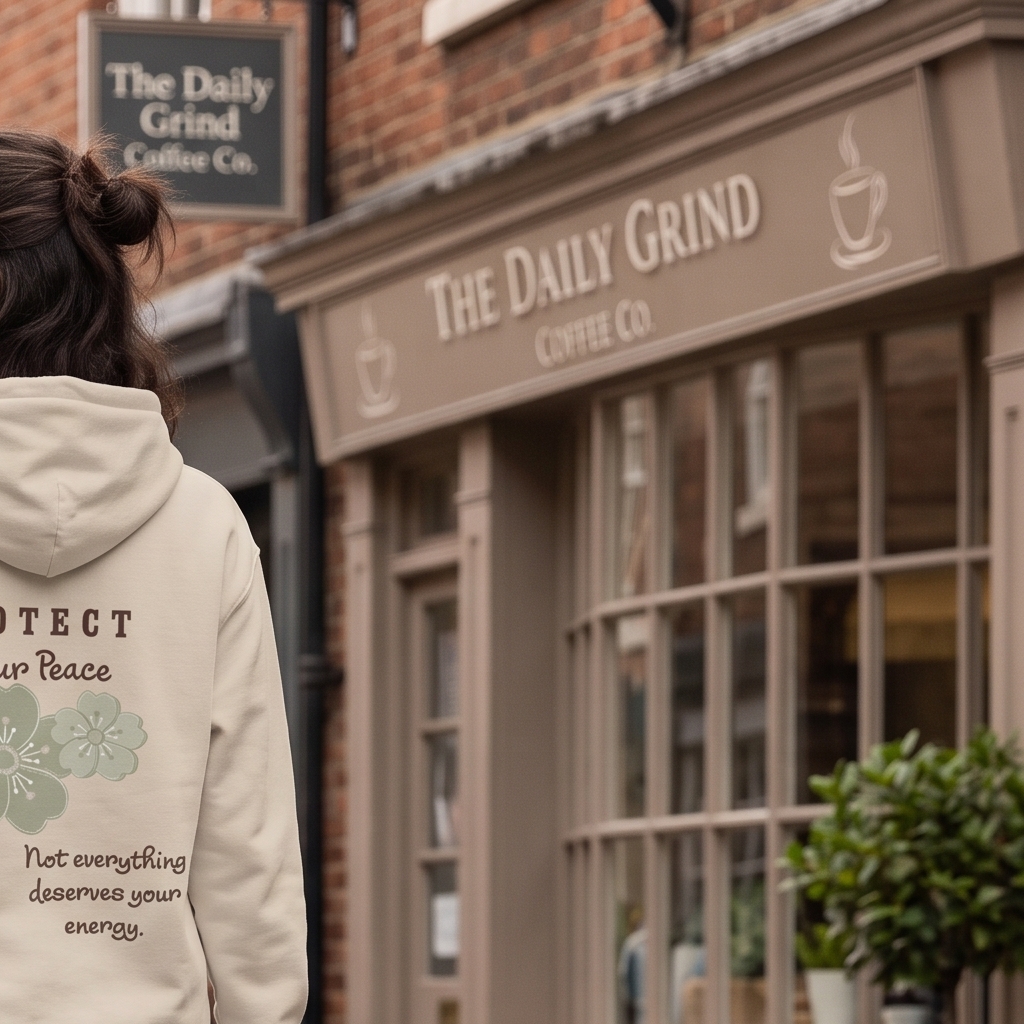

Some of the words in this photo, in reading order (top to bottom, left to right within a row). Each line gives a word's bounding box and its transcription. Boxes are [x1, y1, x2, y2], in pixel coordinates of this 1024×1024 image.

[106, 62, 176, 101] The
[182, 66, 275, 114] Daily
[139, 102, 242, 141] Grind
[213, 146, 259, 175] Co.
[504, 222, 614, 316] DAILY
[625, 173, 761, 273] GRIND
[35, 649, 112, 682] Peace
[24, 844, 69, 869] Not
[73, 845, 186, 875] everything
[29, 877, 125, 905] deserves
[127, 888, 182, 908] your
[64, 920, 144, 942] energy.
